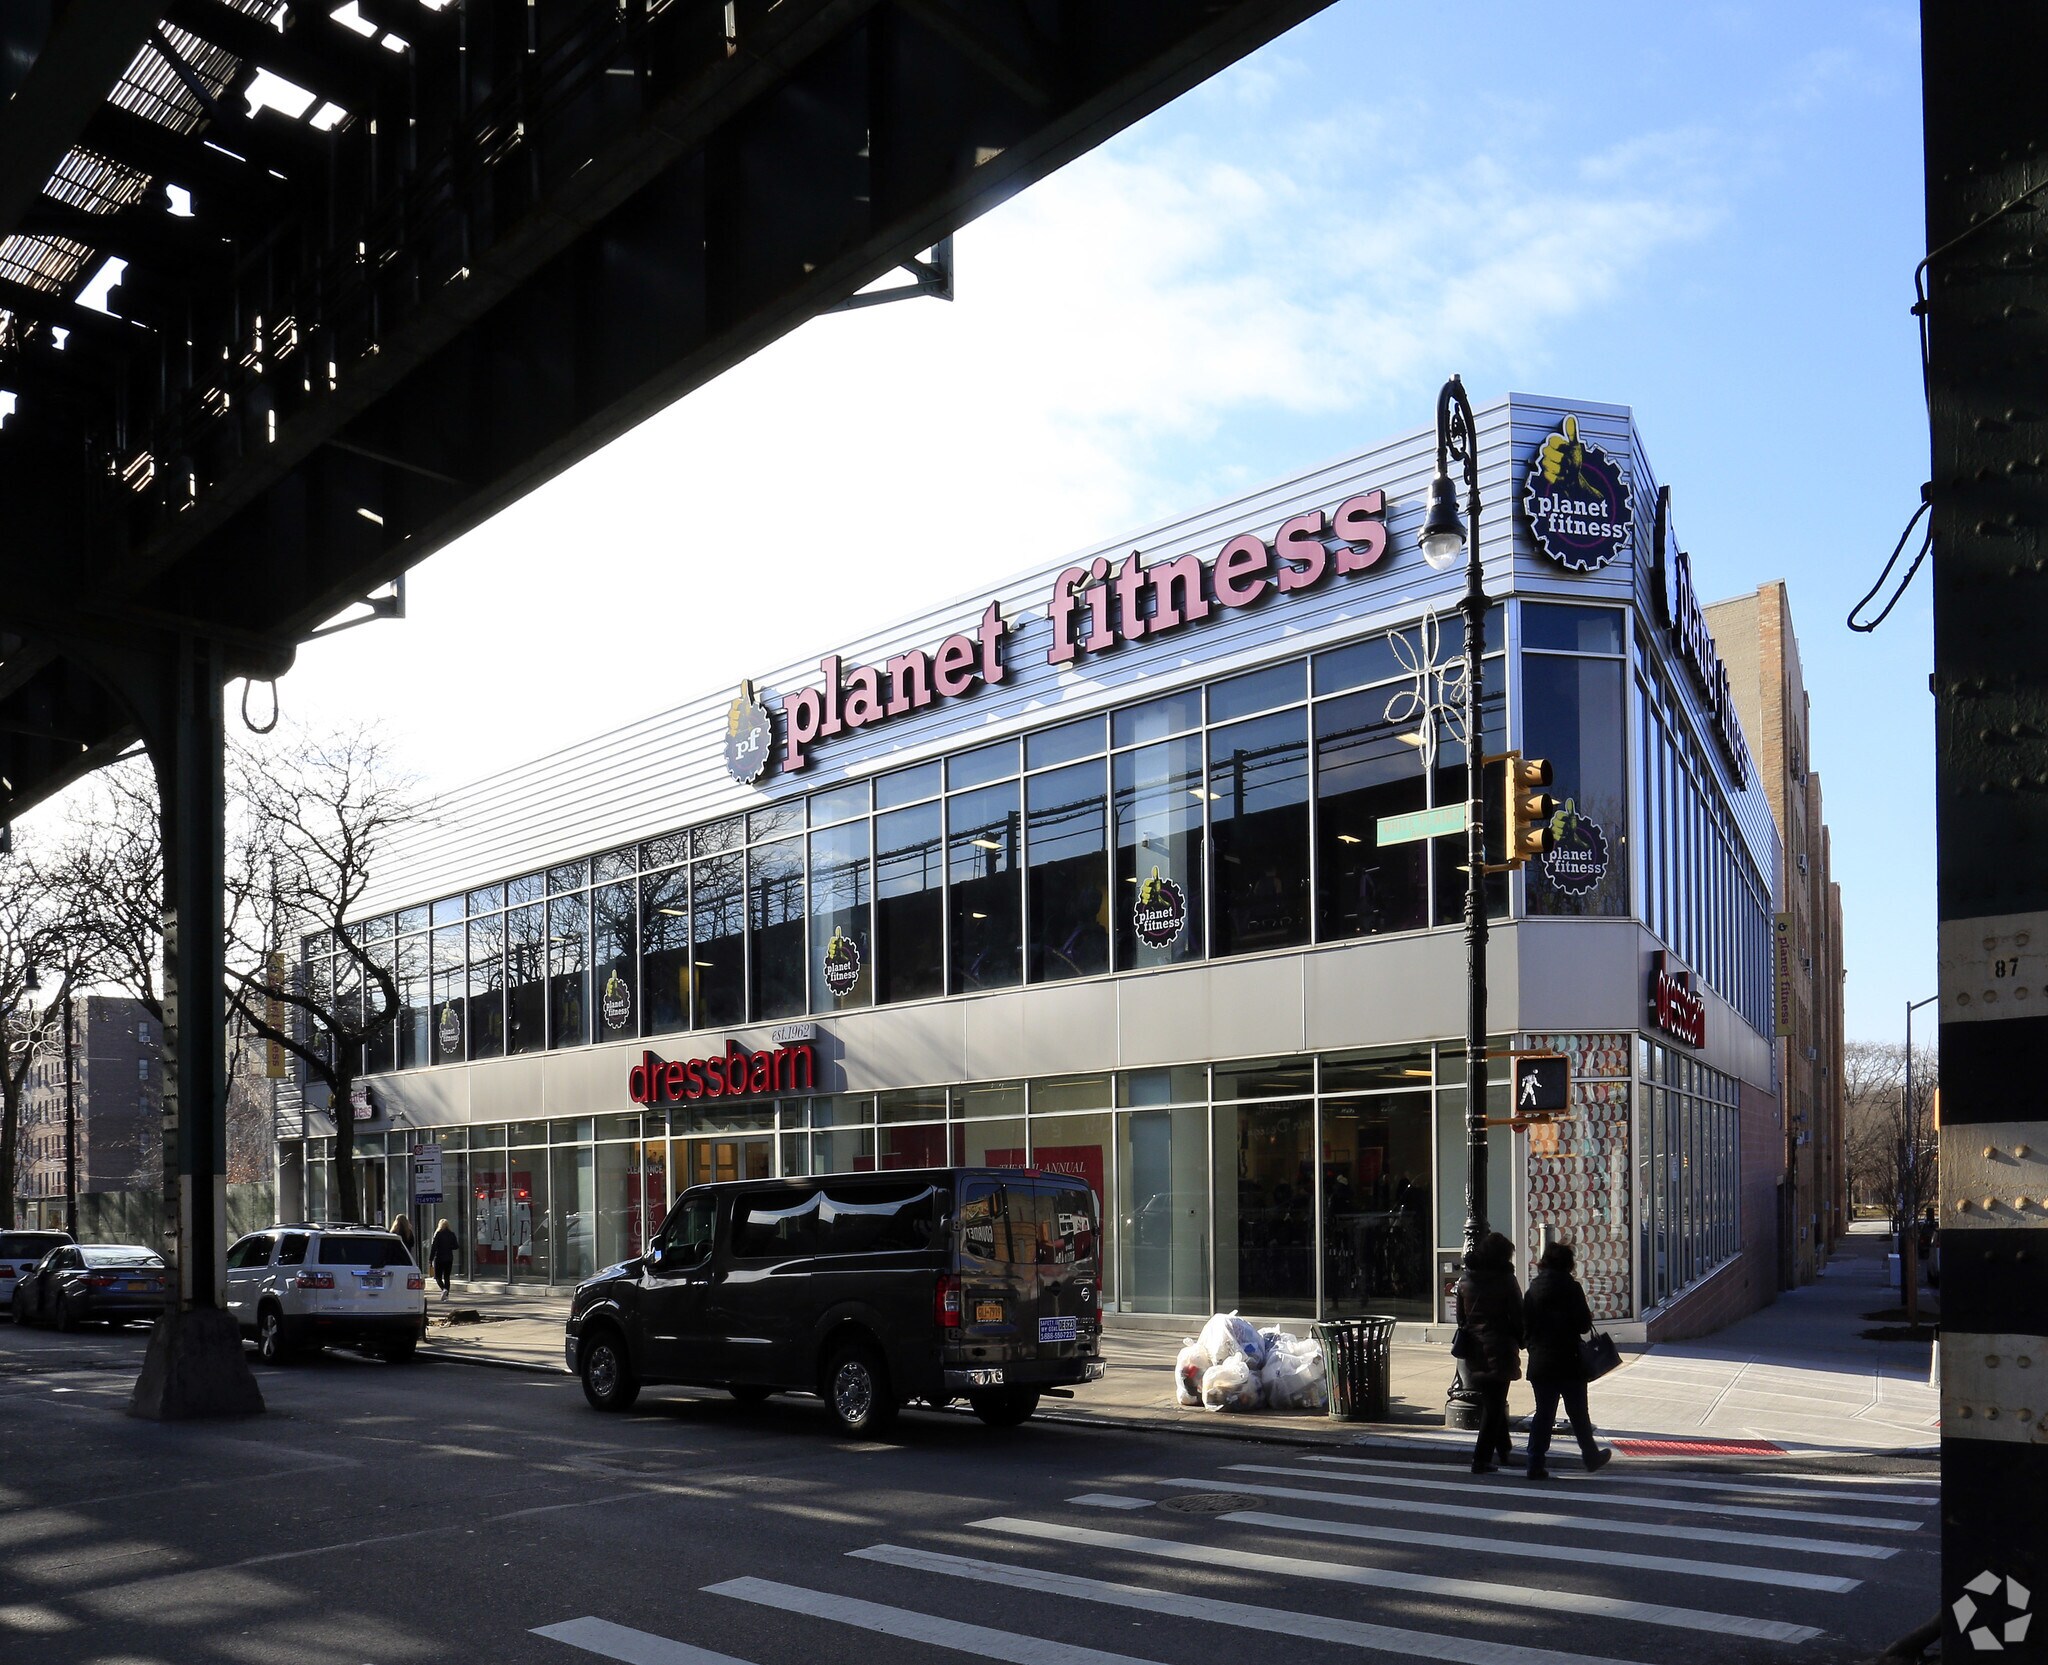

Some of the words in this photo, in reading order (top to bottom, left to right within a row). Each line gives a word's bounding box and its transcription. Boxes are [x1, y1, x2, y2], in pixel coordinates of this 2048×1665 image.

[1538, 493, 1609, 517] planet
[1549, 514, 1623, 538] fitness
[782, 600, 1008, 773] planet
[1047, 489, 1387, 665] fitness
[735, 727, 762, 760] pf
[1549, 847, 1592, 863] planet
[1555, 860, 1602, 873] fitness
[1139, 906, 1173, 925] planet
[1143, 918, 1180, 932] fitness
[1777, 937, 1789, 977] planet
[1995, 957, 2019, 978] 87
[827, 961, 851, 976] planet
[830, 970, 856, 982] fitness
[1780, 981, 1790, 1025] fitness
[629, 1039, 814, 1103] dressbarn
